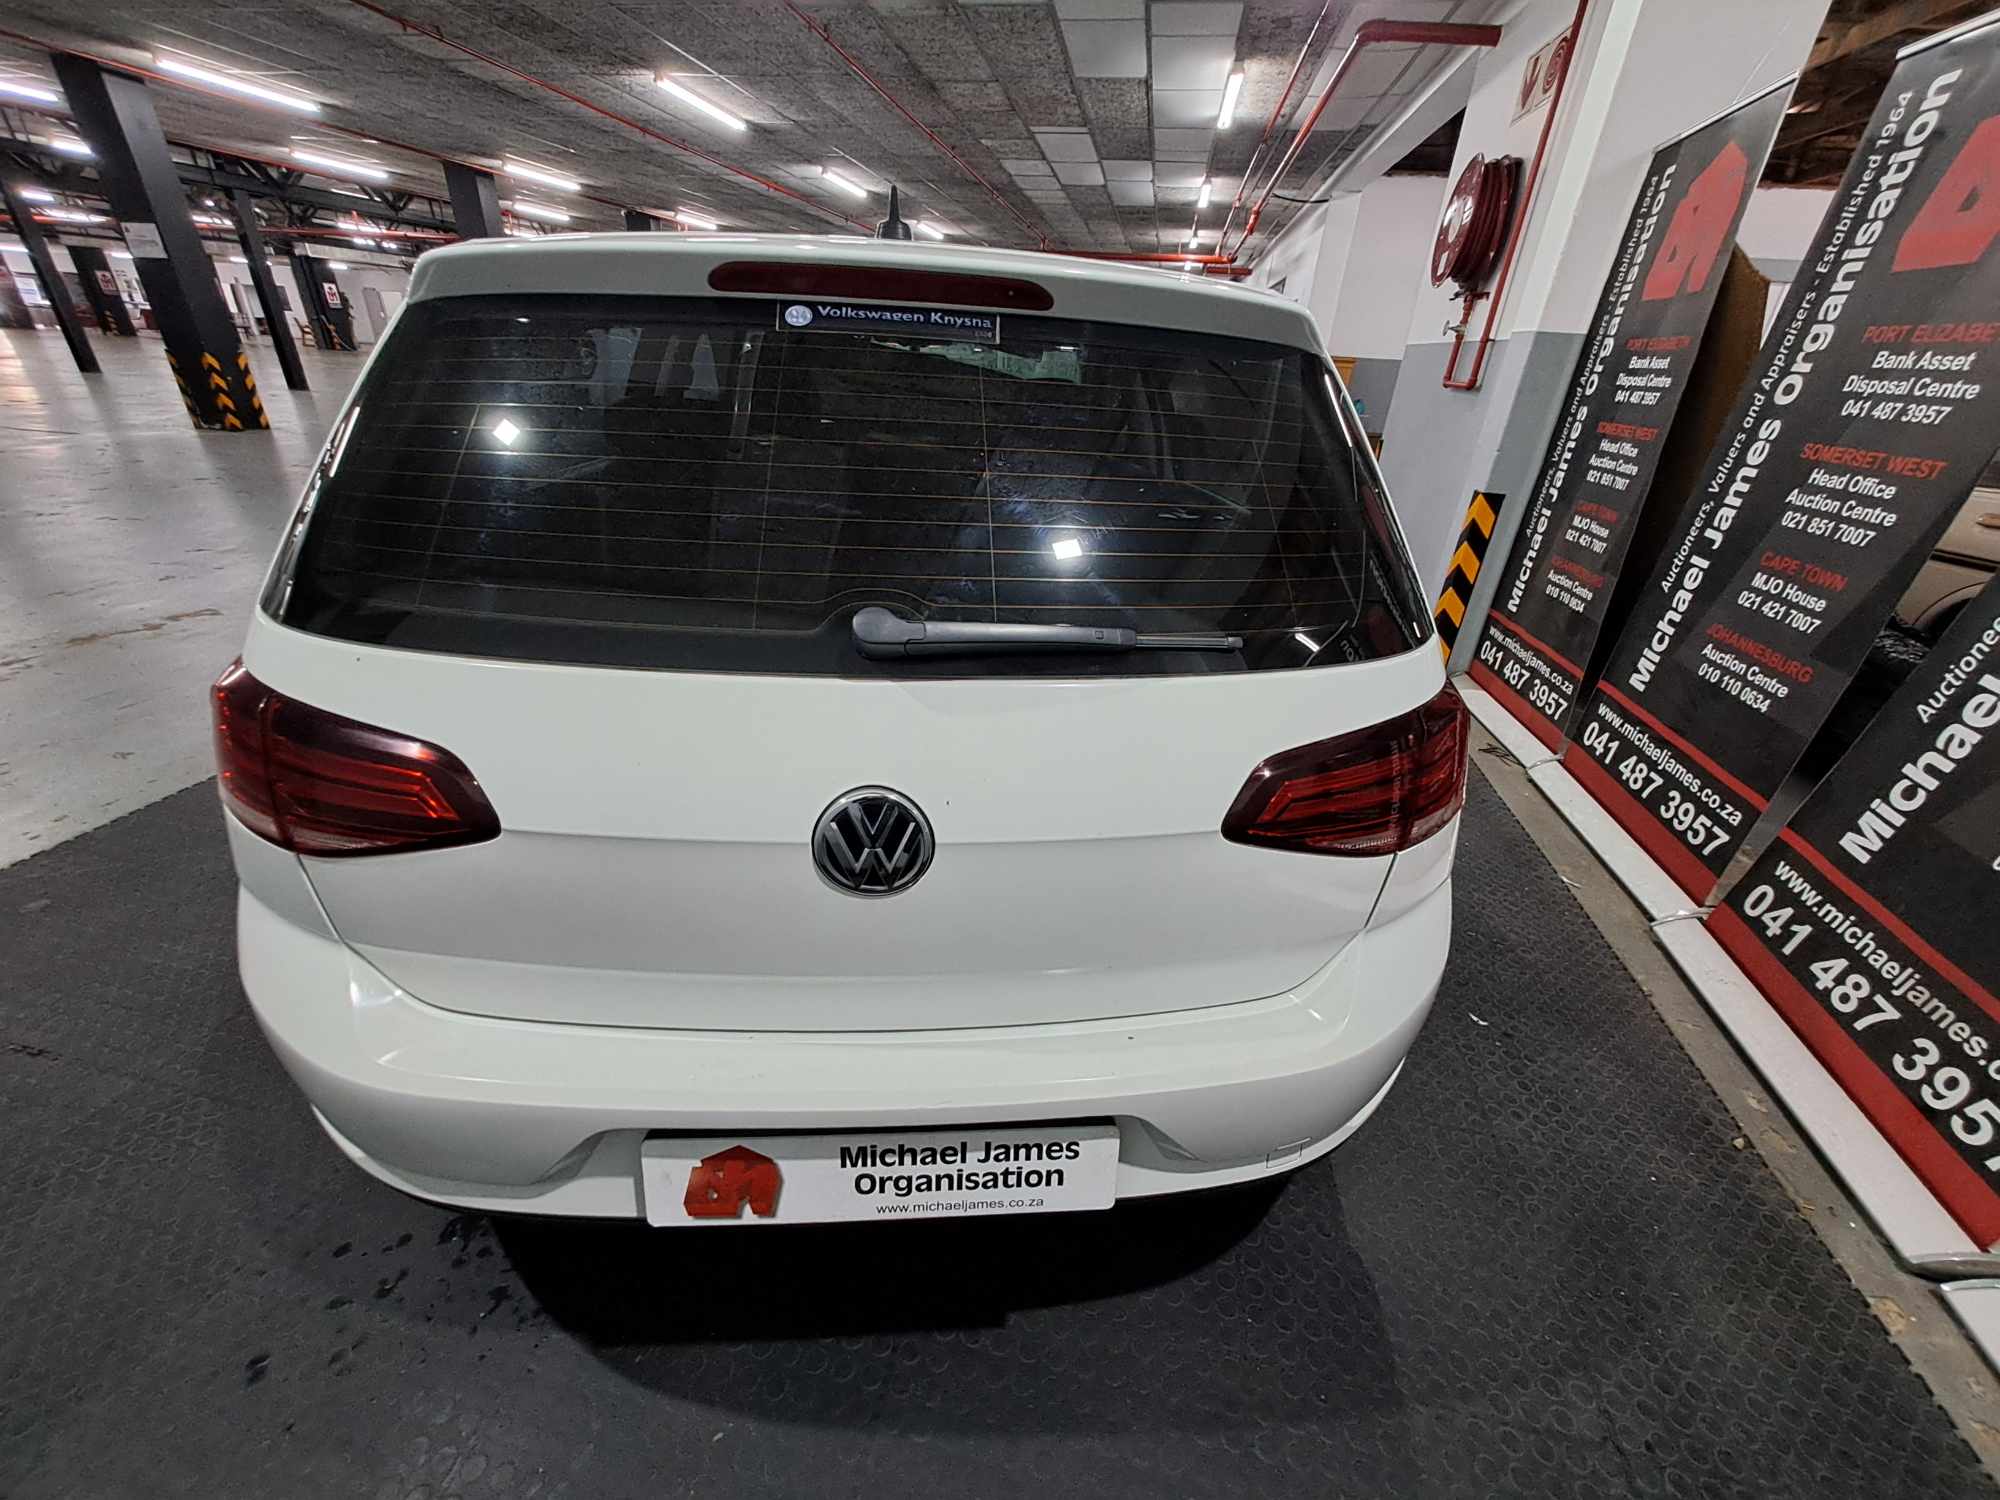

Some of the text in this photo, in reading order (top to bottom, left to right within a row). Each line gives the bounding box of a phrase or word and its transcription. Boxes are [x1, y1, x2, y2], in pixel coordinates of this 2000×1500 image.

[816, 305, 993, 329] Volkswagen Knysna
[1552, 416, 1573, 461] Valuers
[1571, 388, 1583, 414] and
[1580, 313, 1609, 386] Appraisers
[1609, 218, 1643, 302] Established
[1640, 176, 1659, 214] 1964
[1862, 325, 1912, 343] PORT
[1661, 500, 1715, 593] Auctioneers,
[1708, 431, 1746, 494] Valuers
[1742, 392, 1766, 430] and
[1760, 291, 1816, 392] Appraisers
[1816, 154, 1882, 274] Established
[1875, 91, 1913, 149] 1964
[1871, 350, 1977, 371] Bank Asset
[1616, 373, 1671, 388] Disposal Centre
[1629, 356, 1671, 369] Bank Asset
[1629, 68, 1963, 693] Michael James Organisation
[1507, 506, 1551, 613] Michael
[1550, 405, 1588, 503] James
[1585, 164, 1677, 396] Organisation
[1614, 390, 1630, 403] 041
[1842, 375, 1981, 400] Disposal Centre
[1841, 399, 1953, 425] 041 487 3957
[1588, 453, 1638, 476] Auction Centre
[1599, 438, 1639, 457] Head Office
[1800, 443, 1949, 480] SOMERSET WEST
[1586, 469, 1601, 483] 021
[1808, 467, 1897, 500] Head Office
[1571, 514, 1609, 539] MJO House
[1785, 488, 1898, 528] Auction Centre
[1781, 510, 1877, 547] 021 851 7007
[1547, 569, 1574, 590] Auction
[1572, 581, 1593, 600] Centre
[1760, 551, 1848, 592] CAPE TOWN
[1751, 572, 1826, 612] MJO House
[1737, 590, 1822, 634] 021 421 7007
[1489, 625, 1574, 695] www.michaeljames.co.za
[1701, 643, 1789, 698] Auction Centre
[1705, 623, 1814, 683] JOHANNESBURG
[1480, 641, 1569, 720] 041 487 3957
[1698, 663, 1771, 713] 010 110 0634
[1597, 702, 1743, 827] www.michaeljames.co.za
[1583, 721, 1731, 856] 041 487 3957
[1743, 884, 2000, 1172] 041 487 395
[840, 1140, 1080, 1168] Michael James
[854, 1166, 1064, 1197] Organisation
[876, 1198, 1044, 1214] www.michaeljames.co.za
